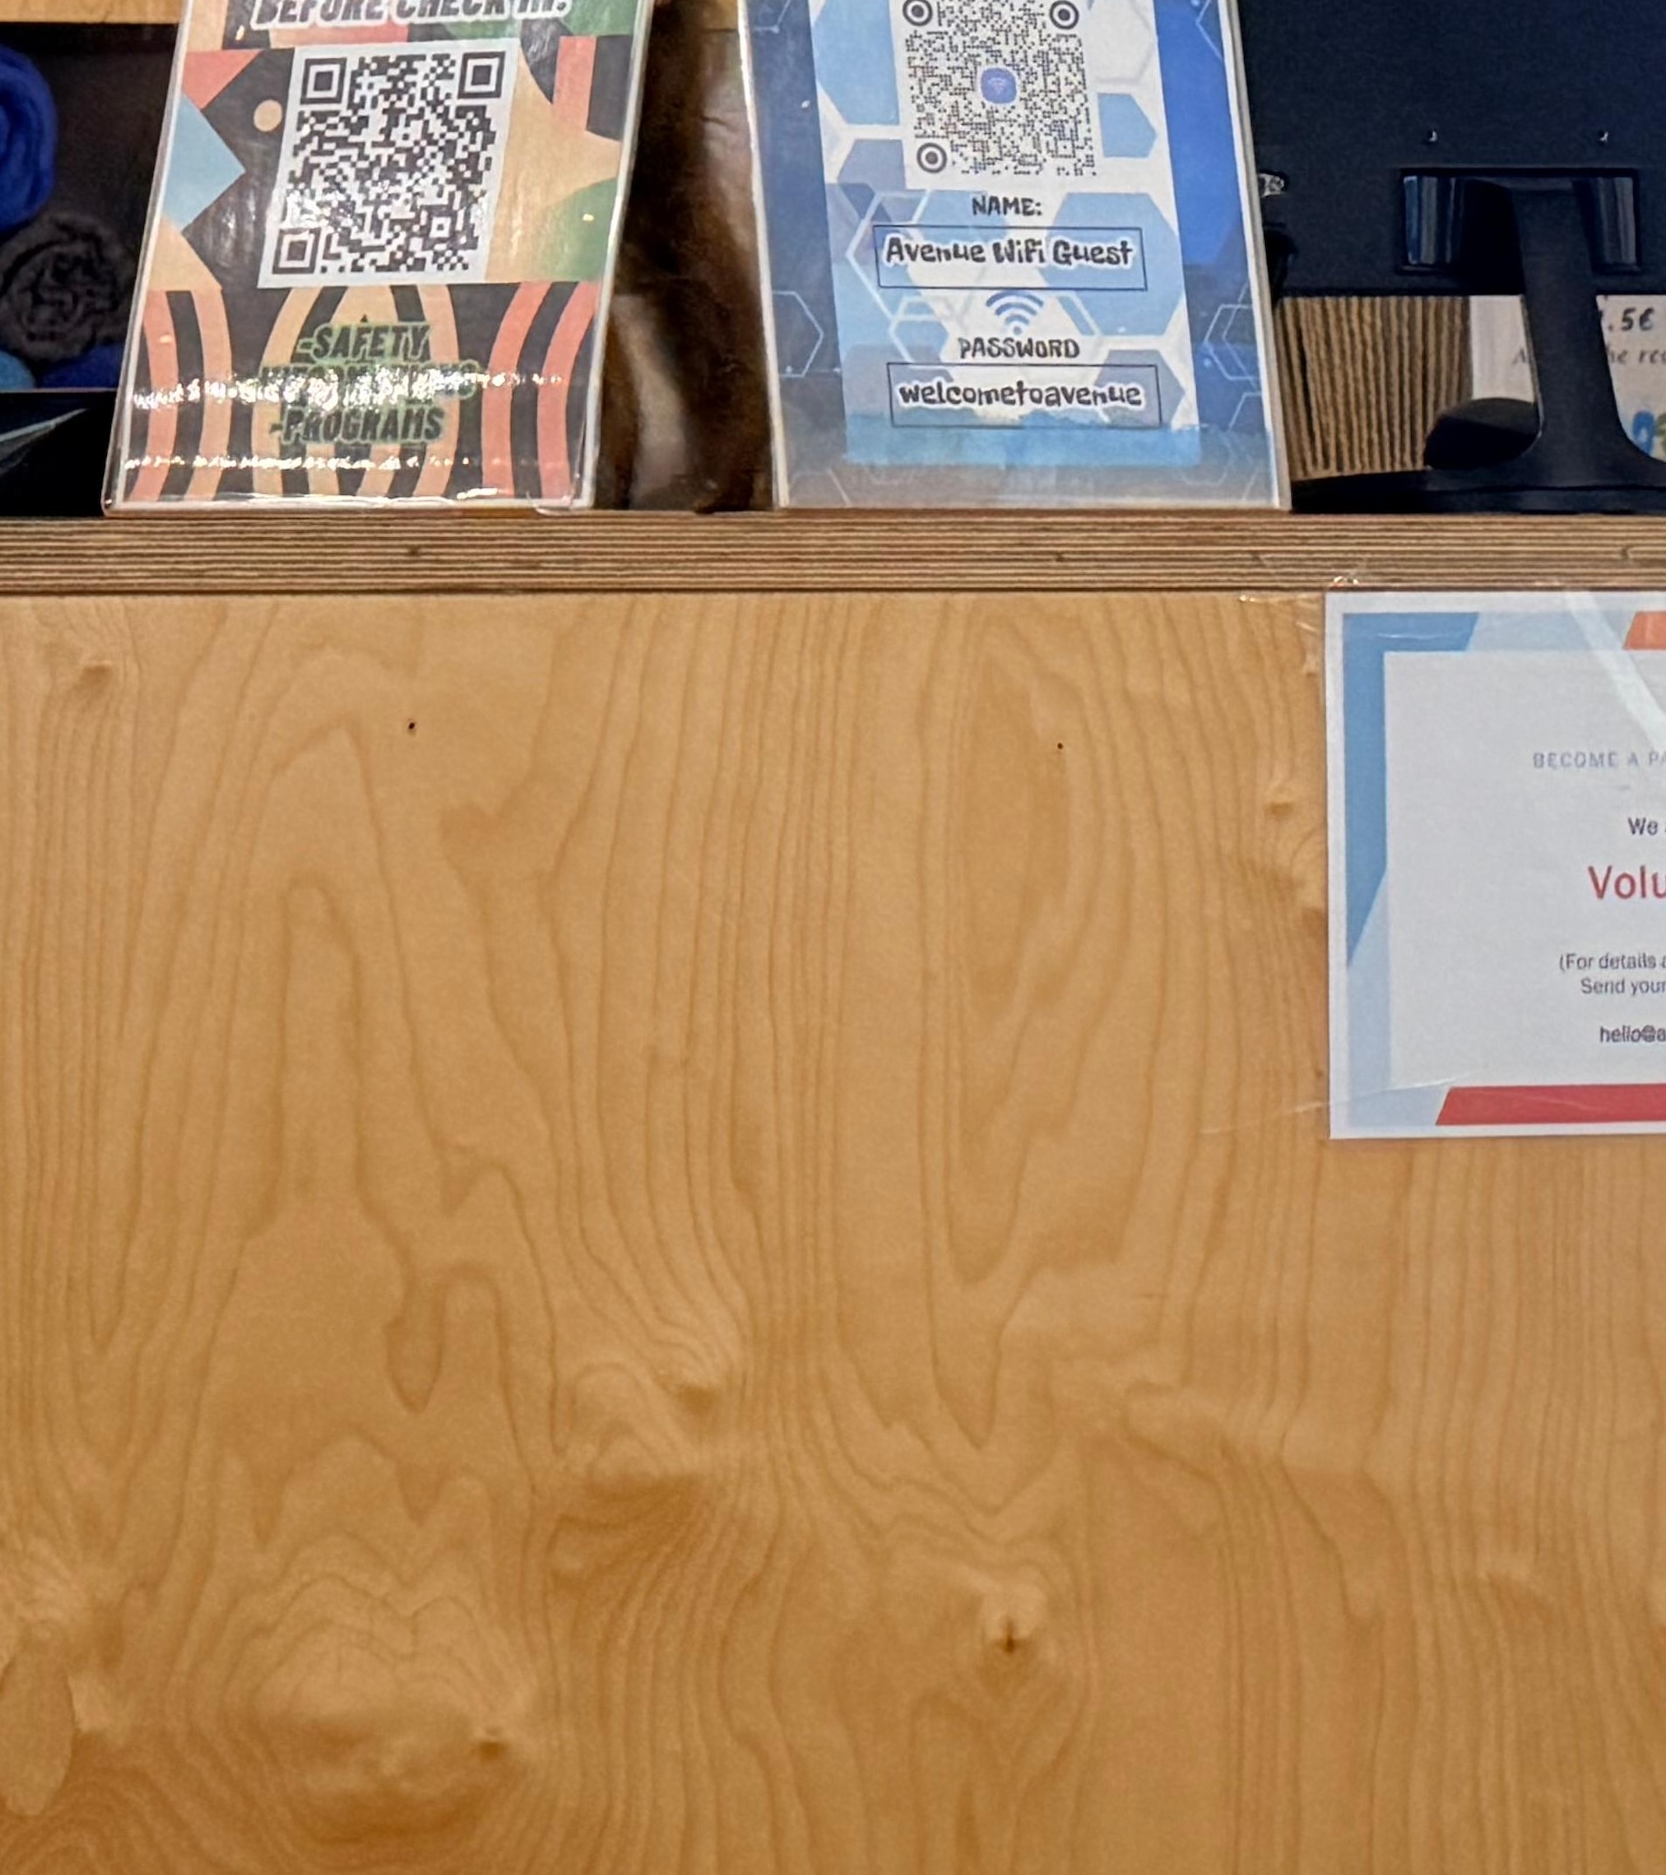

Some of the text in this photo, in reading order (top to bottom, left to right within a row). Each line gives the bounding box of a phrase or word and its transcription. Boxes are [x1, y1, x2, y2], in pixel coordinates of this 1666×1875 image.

[972, 195, 1043, 216] NAME:
[886, 236, 987, 263] Avenue
[1052, 239, 1134, 266] Guest
[958, 337, 1080, 359] PASSWORD
[898, 380, 1143, 407] welcometoavenue
[1533, 751, 1617, 770] BECOME
[1628, 750, 1640, 767] A
[1628, 816, 1659, 836] We
[1559, 952, 1594, 973] (For
[1598, 951, 1657, 970] details
[1581, 977, 1626, 995] Send
[1631, 978, 1666, 997] your
